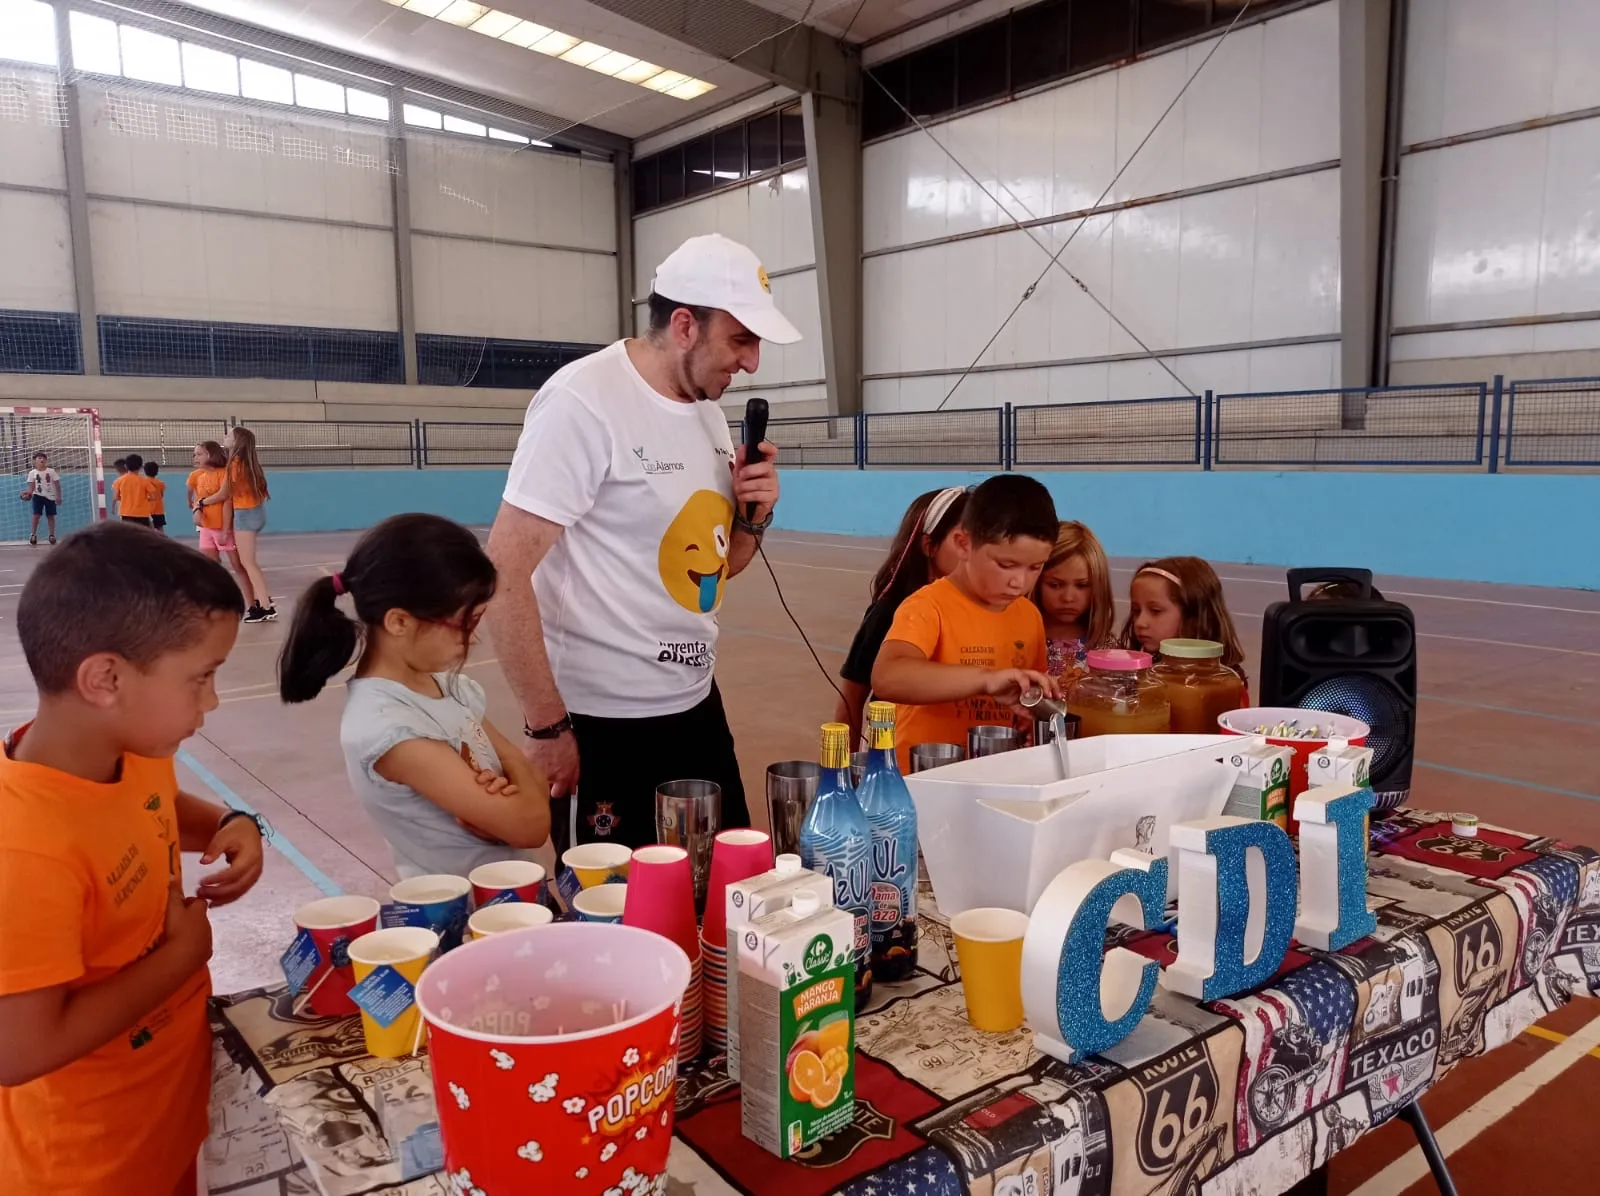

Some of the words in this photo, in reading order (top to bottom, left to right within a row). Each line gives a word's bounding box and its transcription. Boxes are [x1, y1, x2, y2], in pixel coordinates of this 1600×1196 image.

[1461, 923, 1496, 986] 66
[797, 990, 839, 1017] NARANJA
[801, 980, 836, 1003] MANGO
[1351, 1028, 1435, 1079] TEXACO
[1151, 1073, 1209, 1160] 66
